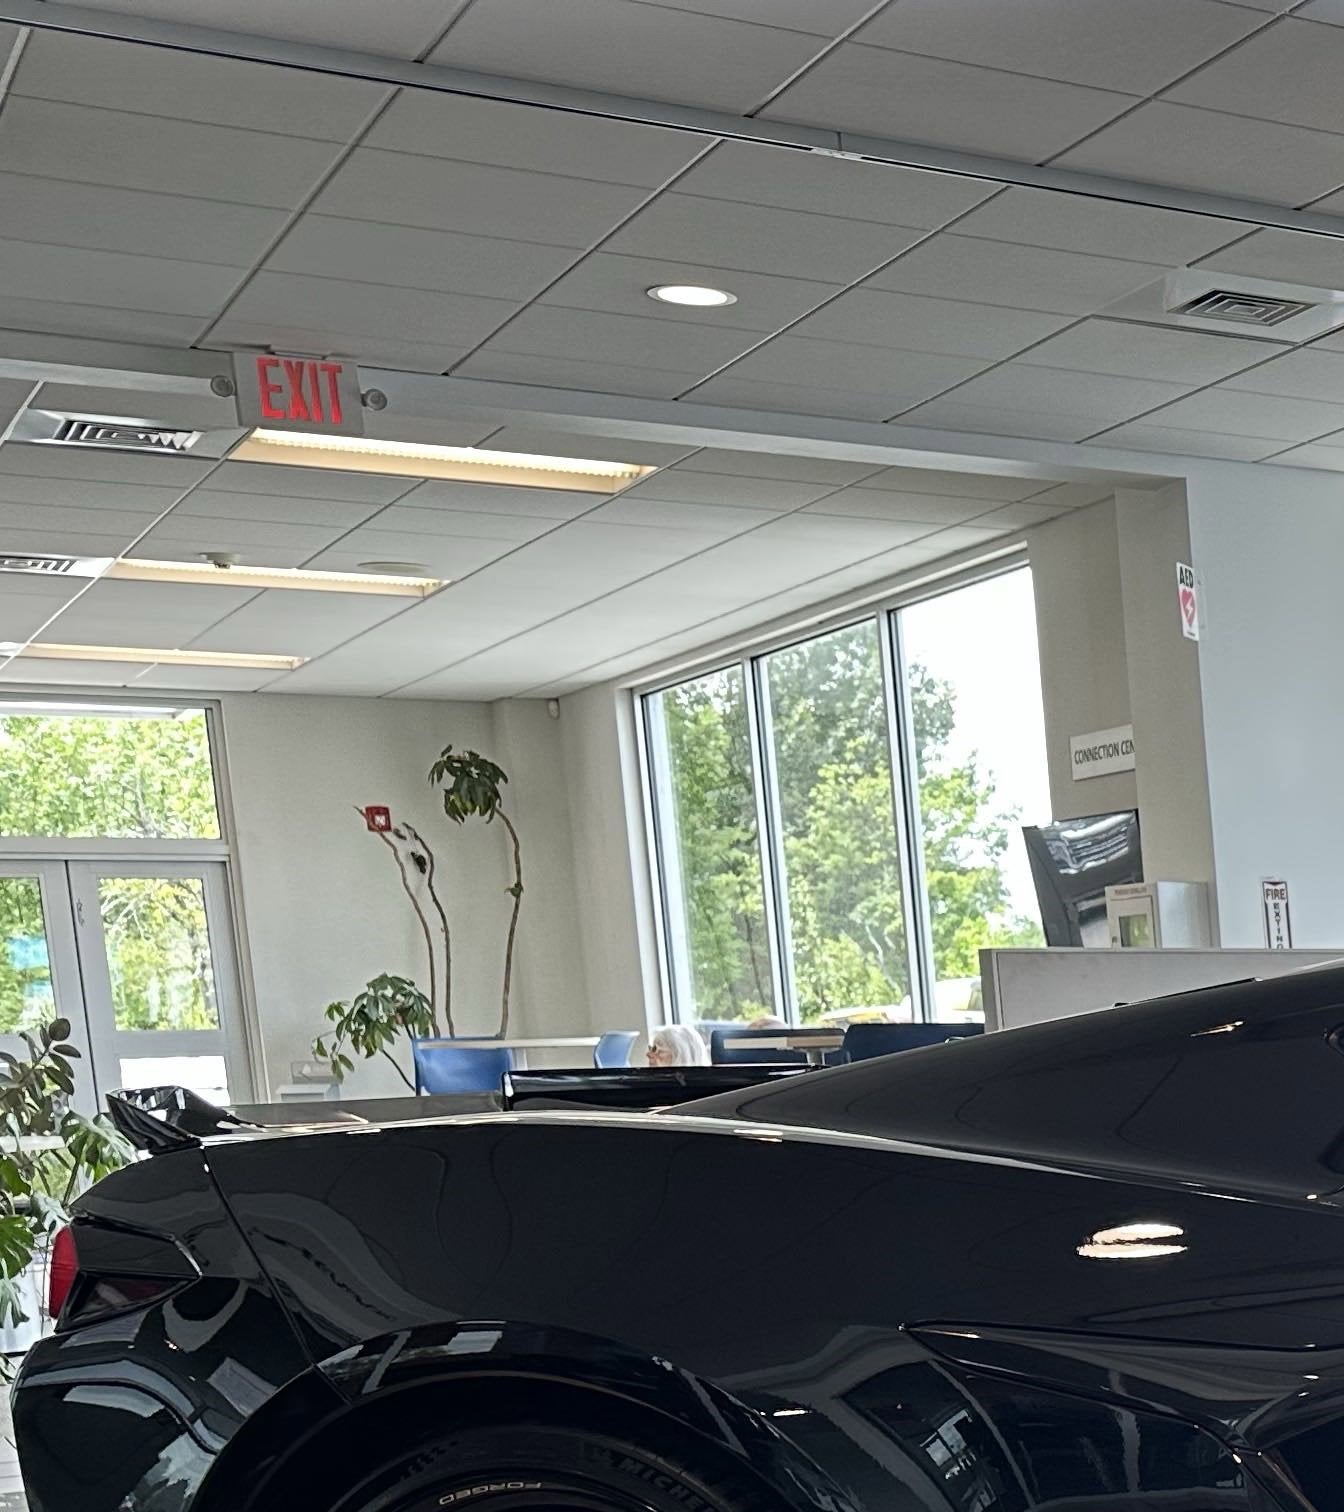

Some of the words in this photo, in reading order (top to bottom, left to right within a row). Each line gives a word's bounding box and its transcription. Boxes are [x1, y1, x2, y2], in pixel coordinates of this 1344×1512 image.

[256, 357, 343, 425] EXIT
[1179, 566, 1194, 589] AED
[1074, 742, 1120, 765] CONNECTION
[1265, 888, 1286, 900] FIRE
[439, 1481, 543, 1506] FORGED
